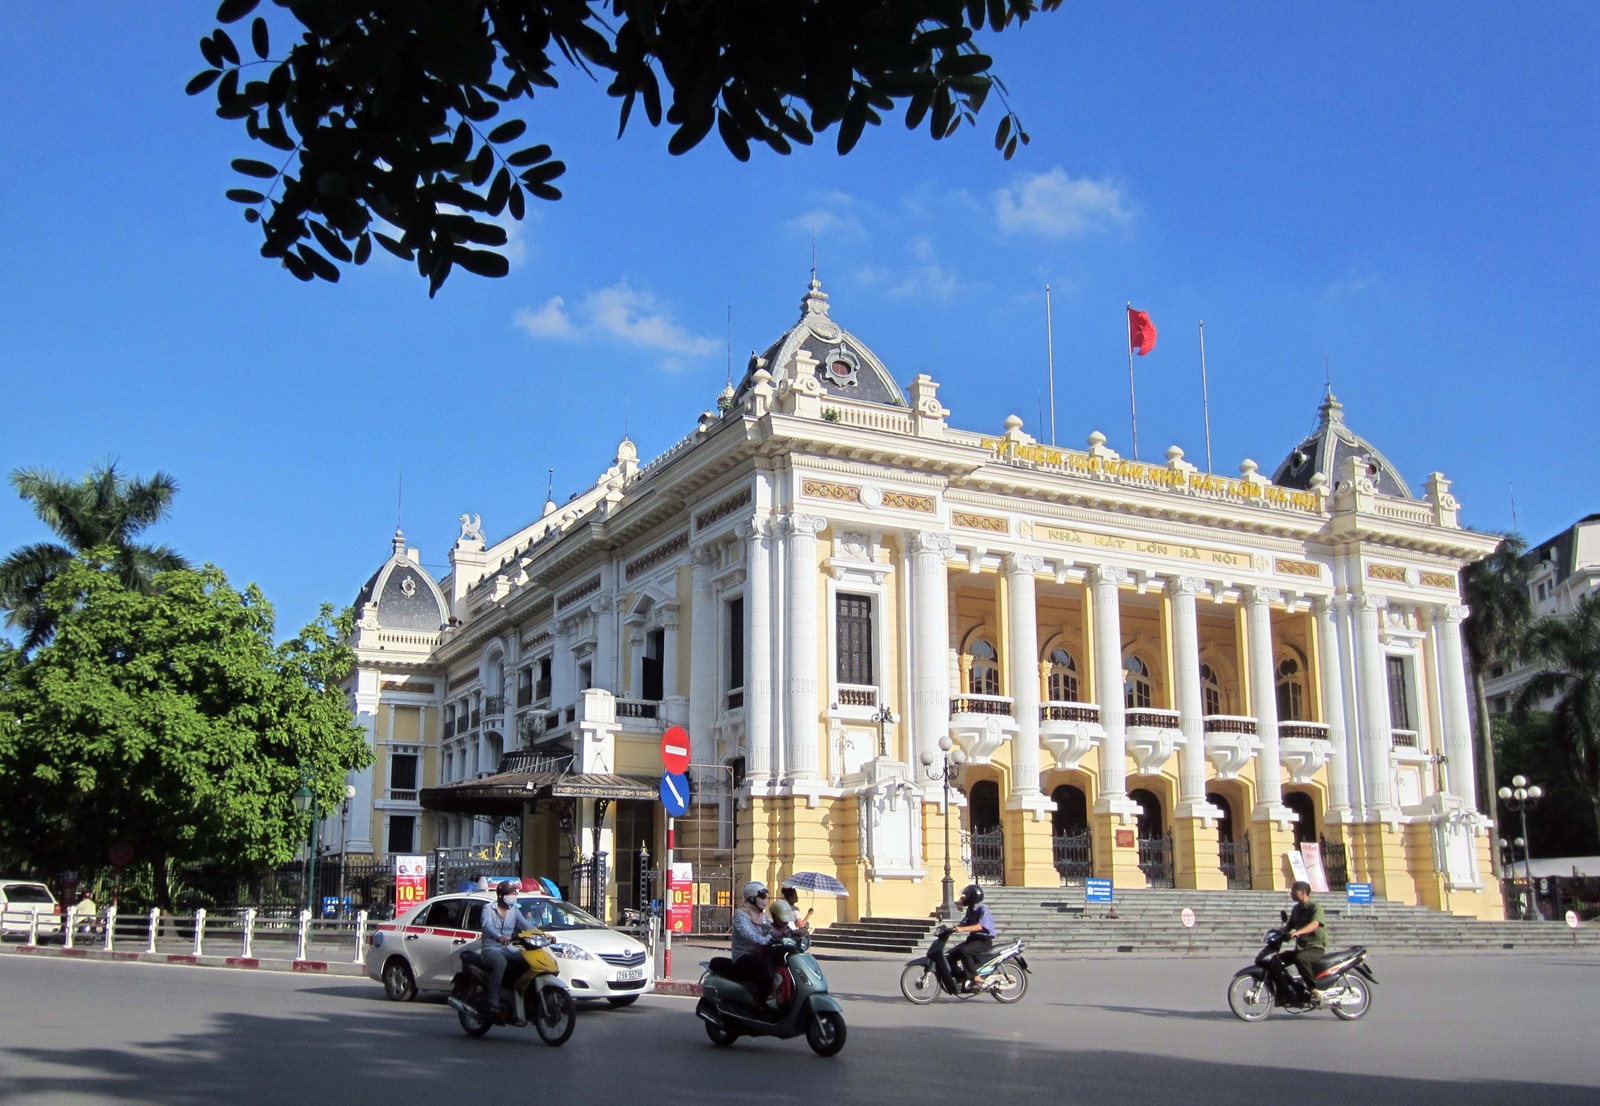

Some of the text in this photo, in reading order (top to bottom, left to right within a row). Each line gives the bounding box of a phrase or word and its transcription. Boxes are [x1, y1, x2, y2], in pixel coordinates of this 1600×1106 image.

[1068, 453, 1099, 472] 100
[1189, 474, 1224, 492] HÁT
[398, 886, 414, 900] 10
